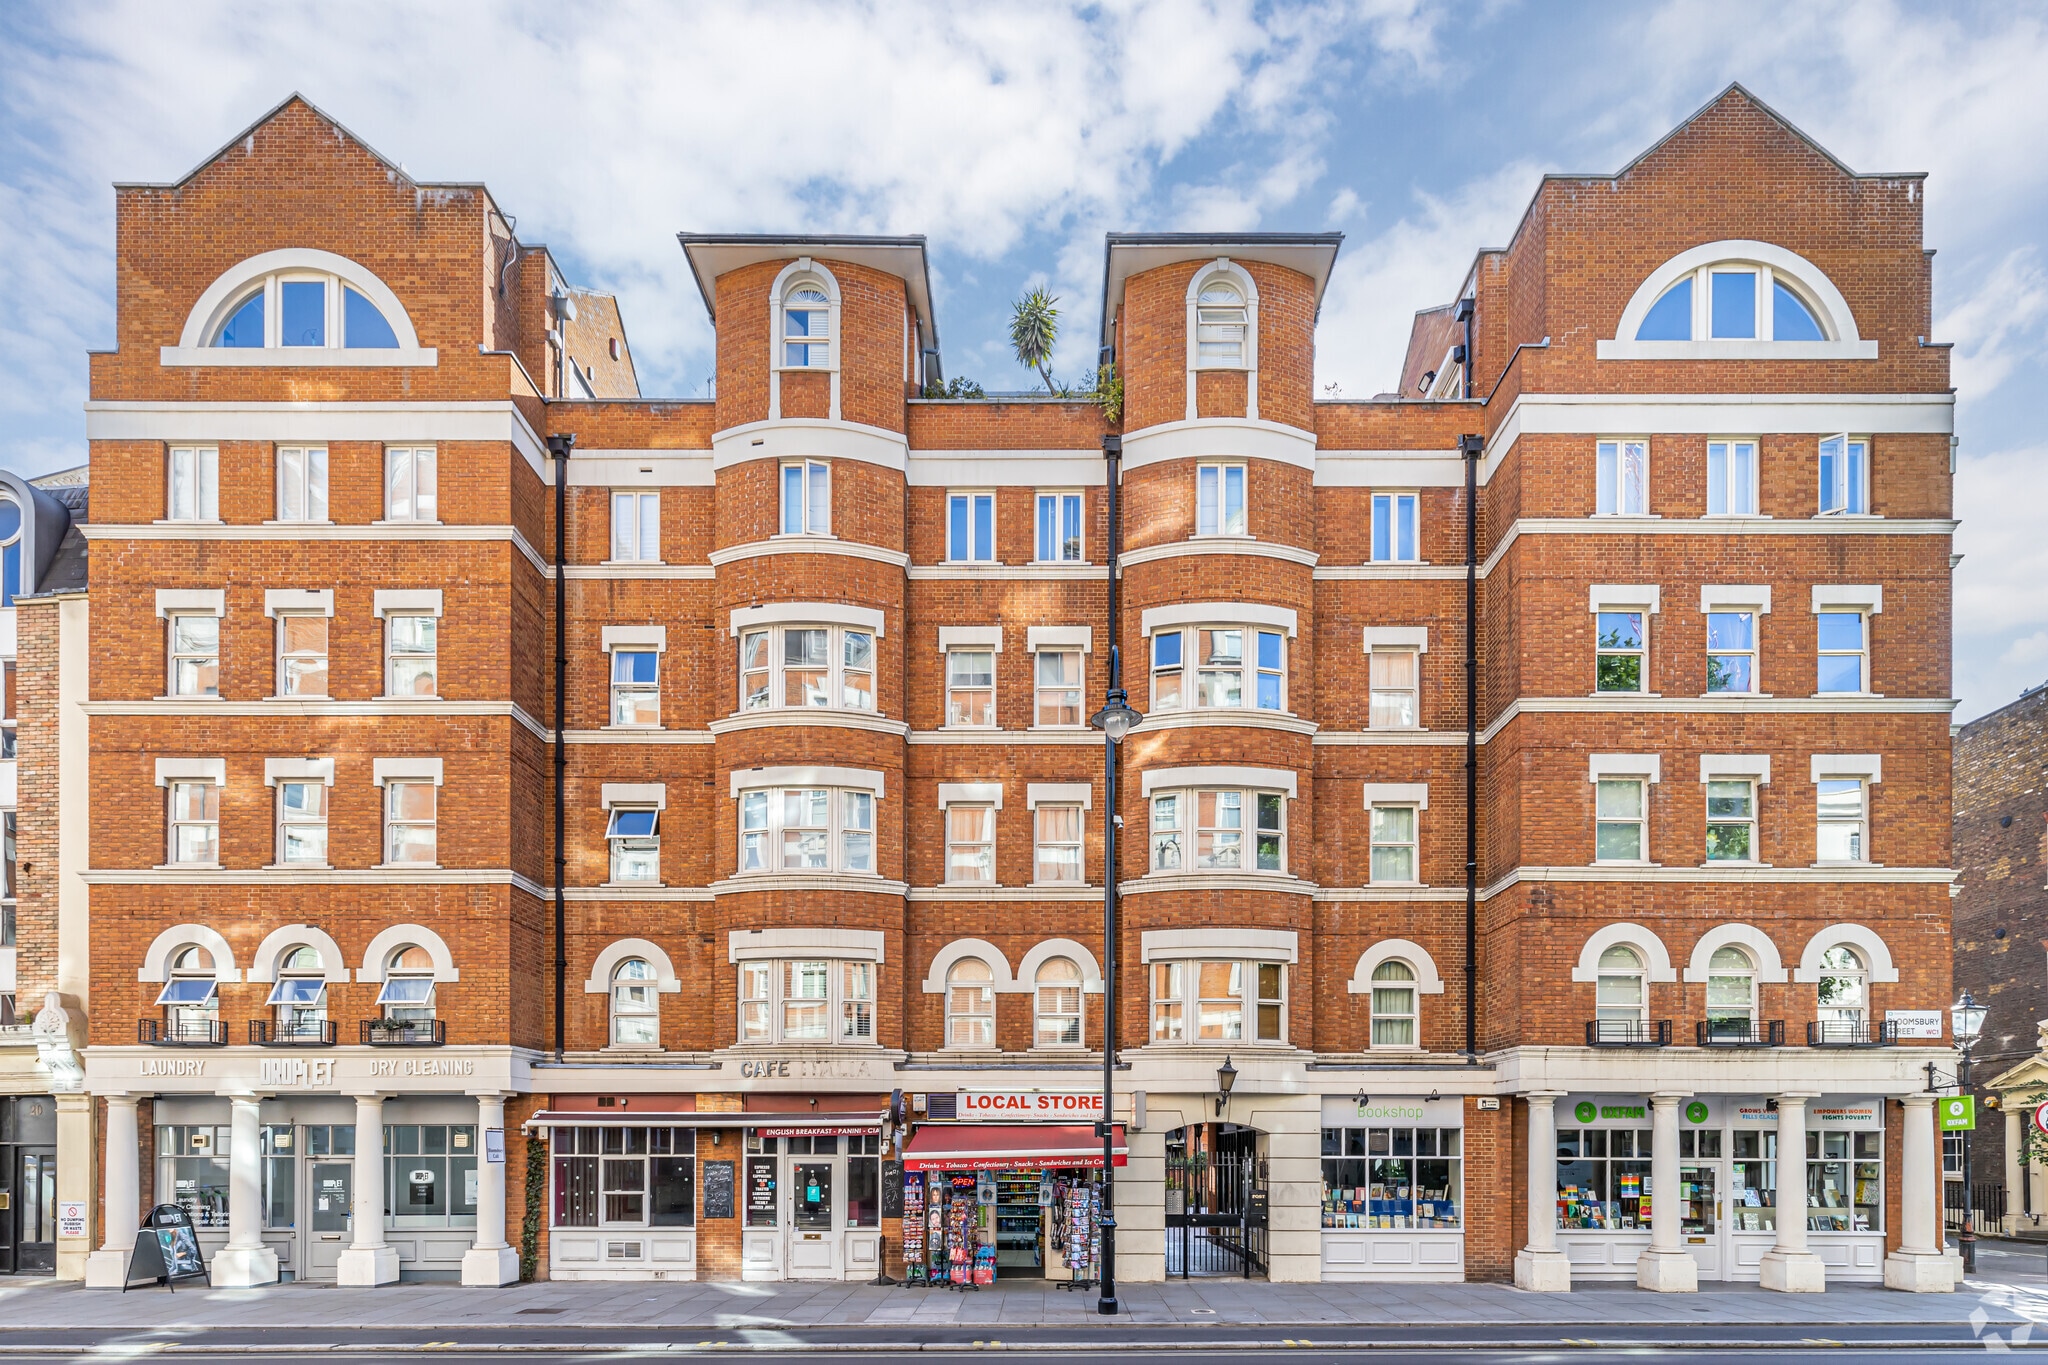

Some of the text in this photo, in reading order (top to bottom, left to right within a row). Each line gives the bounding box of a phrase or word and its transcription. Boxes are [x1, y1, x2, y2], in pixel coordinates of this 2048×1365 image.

[139, 1060, 205, 1075] LAUNDRY
[260, 1058, 336, 1089] DROPLET
[369, 1059, 473, 1076] DRY CLEANING
[741, 1060, 790, 1077] CAFE
[966, 1096, 1103, 1109] LOCAL STORE
[1358, 1105, 1423, 1120] Bookshop
[1601, 1106, 1645, 1119] OXFAM
[952, 1177, 975, 1186] OPEN
